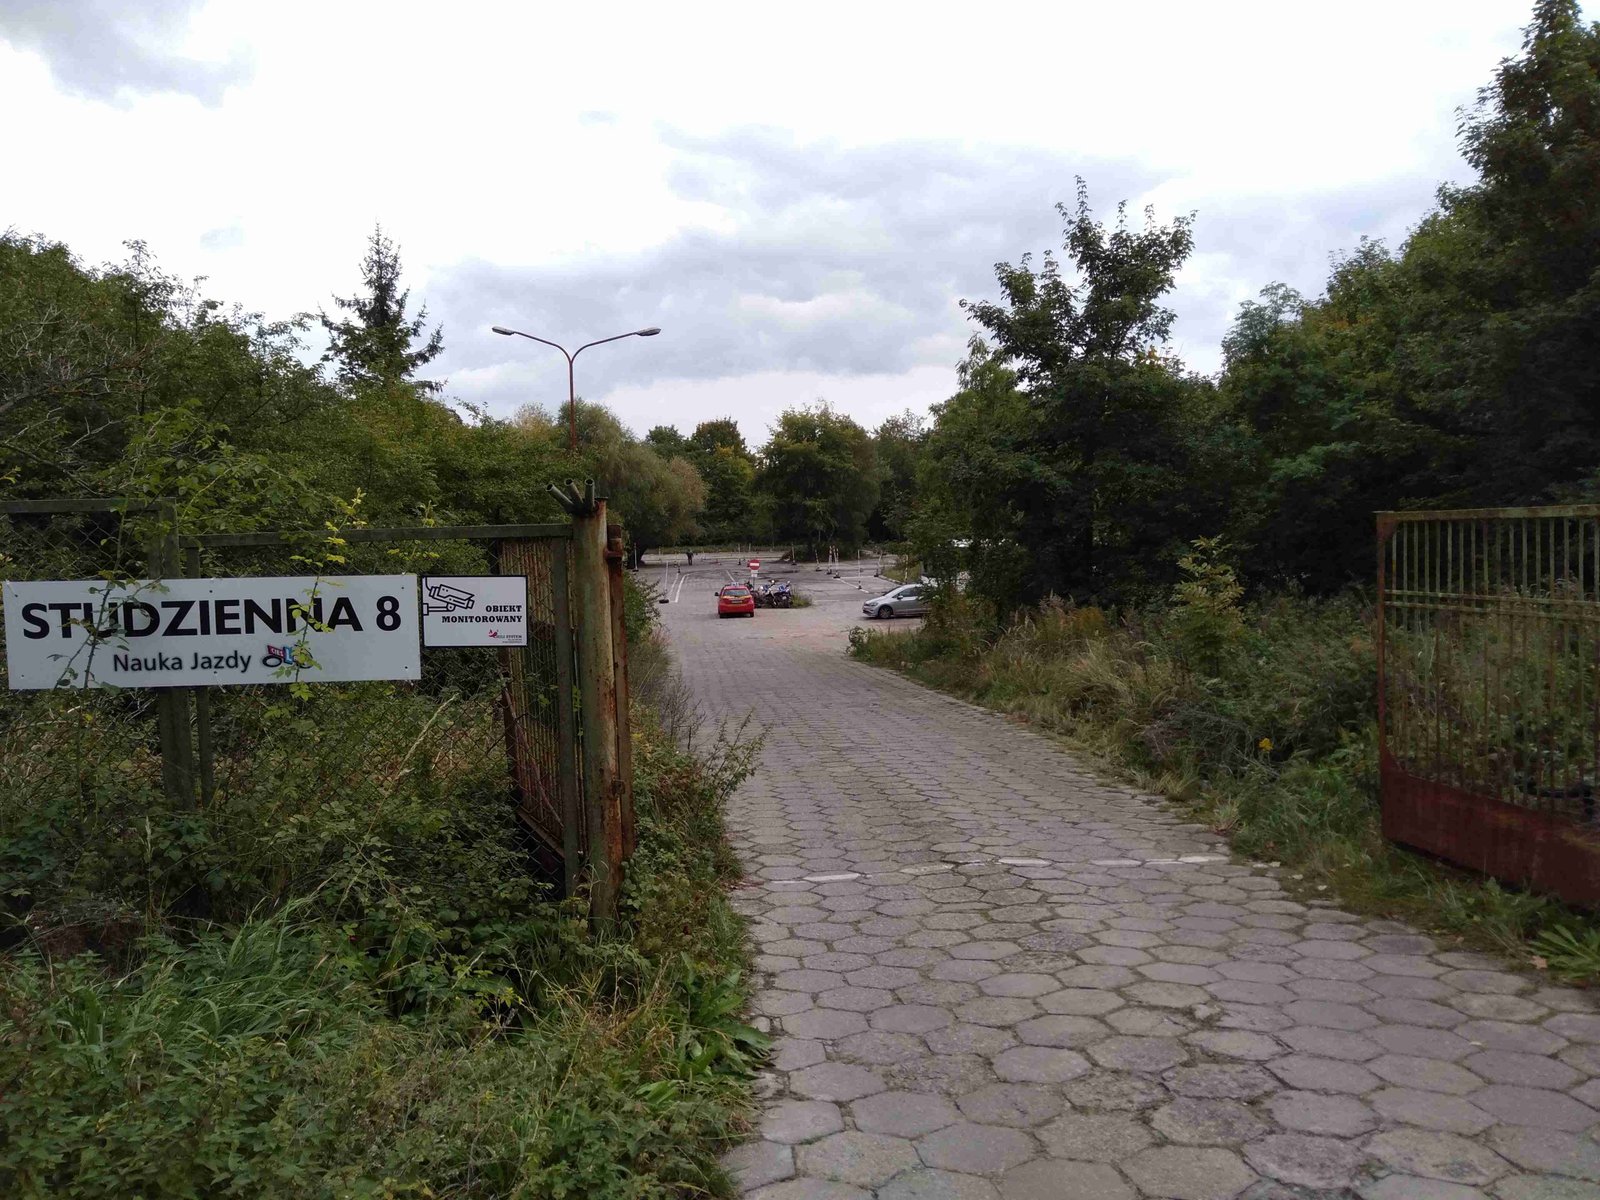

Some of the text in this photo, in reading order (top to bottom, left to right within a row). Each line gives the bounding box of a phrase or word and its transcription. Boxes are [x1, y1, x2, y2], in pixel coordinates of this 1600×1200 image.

[485, 604, 523, 613] OBIEKT
[21, 595, 402, 640] STUDZIENNA 8
[441, 615, 523, 624] MONITOROWANY
[113, 650, 252, 673] Nauka Jazdy
